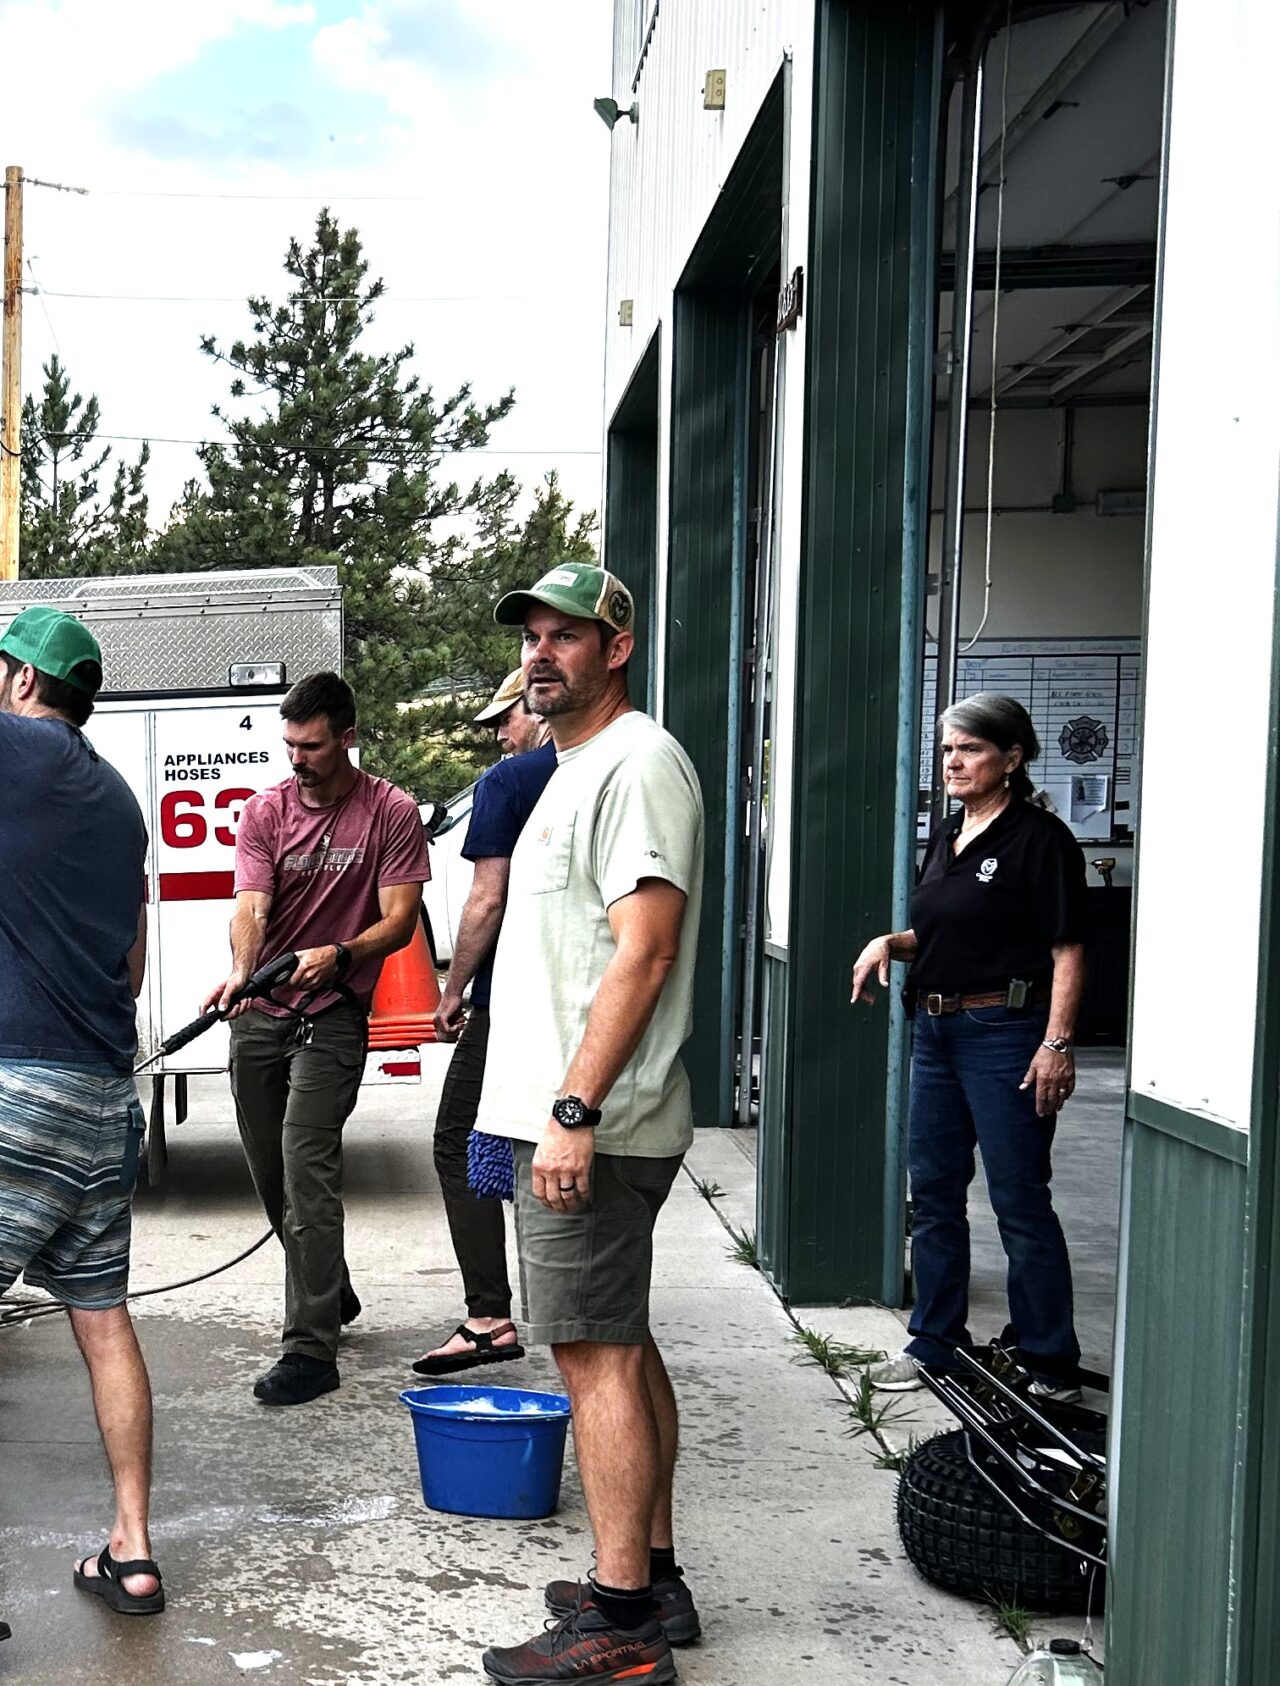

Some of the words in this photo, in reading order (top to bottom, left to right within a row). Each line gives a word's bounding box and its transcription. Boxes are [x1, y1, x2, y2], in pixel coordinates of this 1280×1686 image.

[239, 715, 253, 730] 4
[164, 751, 270, 767] APPLIANCES
[164, 768, 221, 781] HOSES
[573, 1659, 589, 1671] LA
[590, 1640, 646, 1665] SPORTIVA
